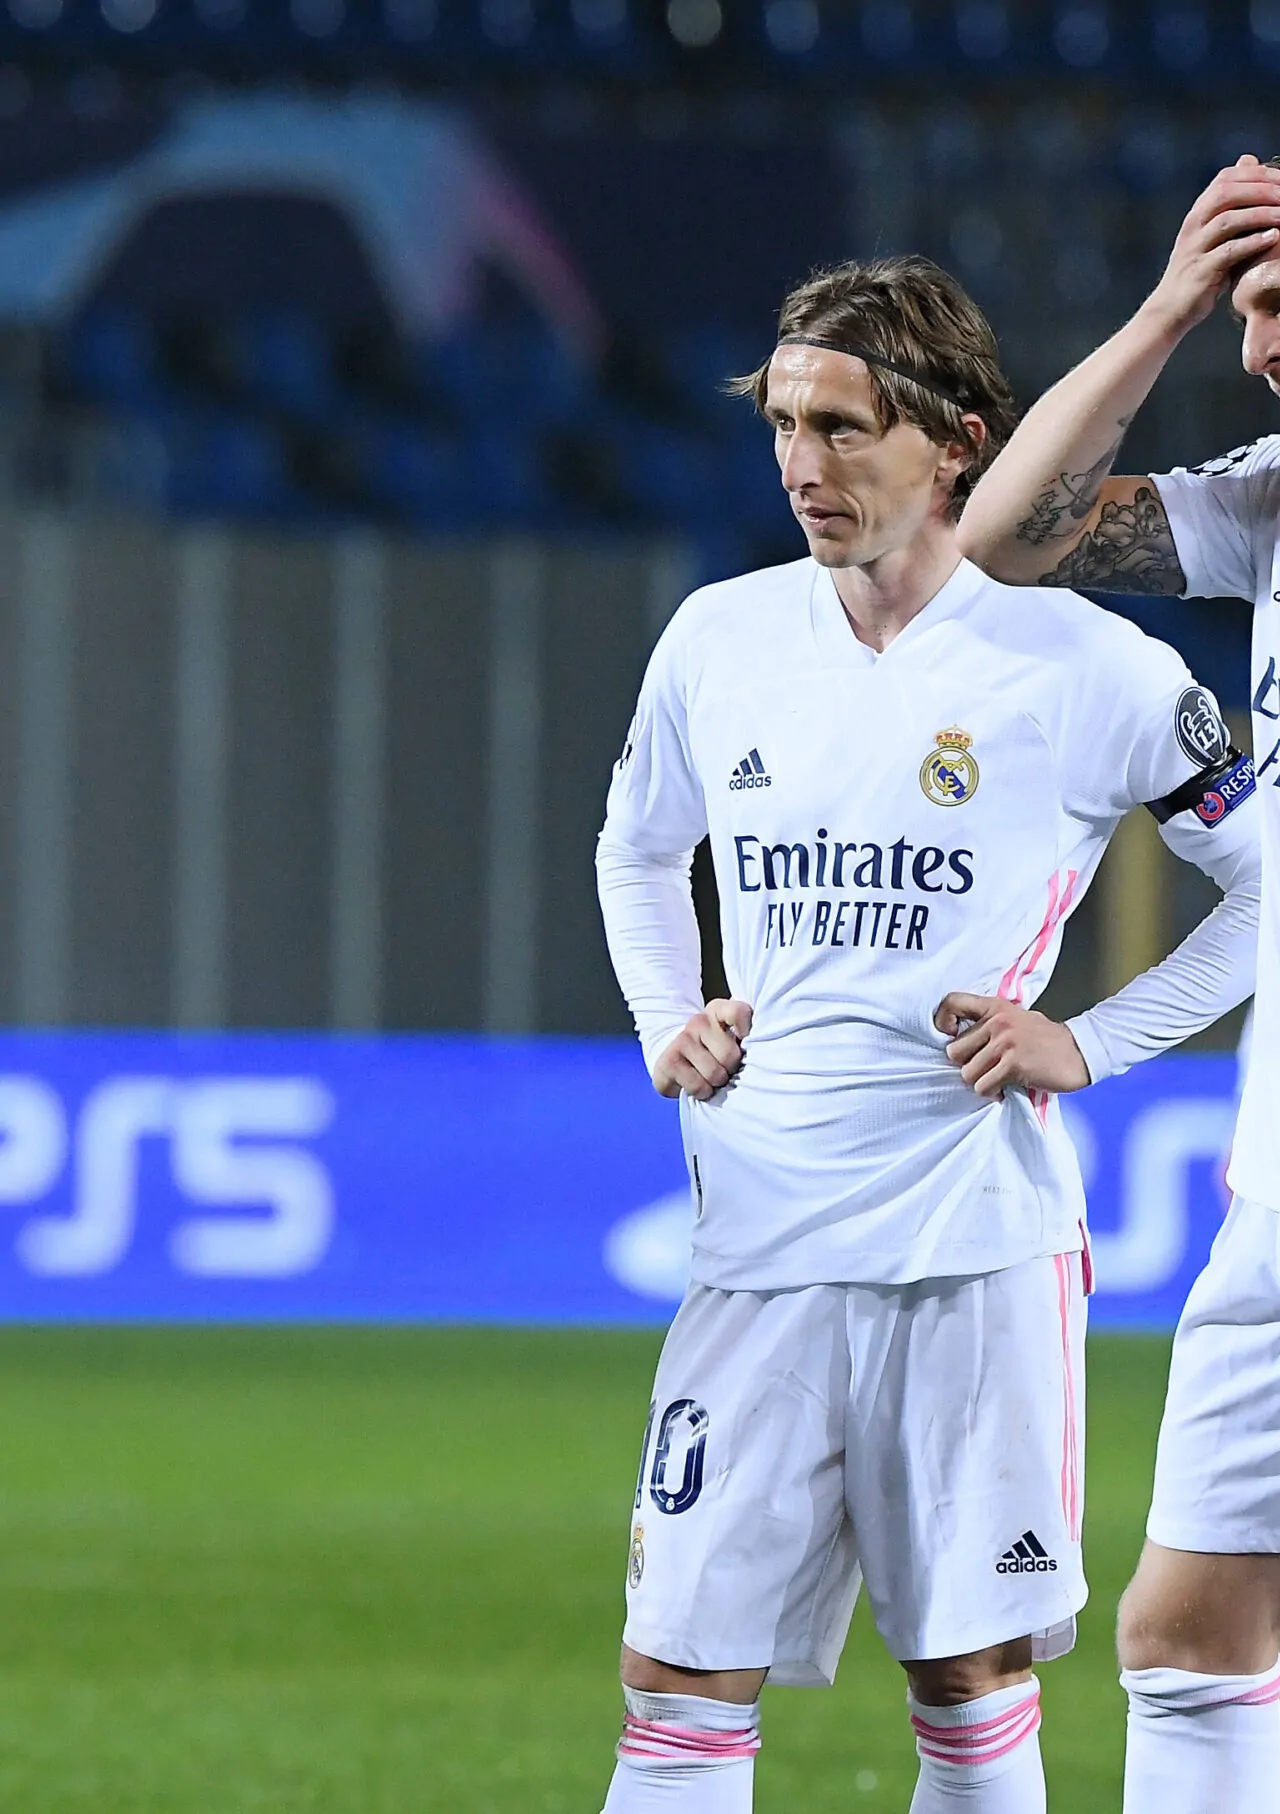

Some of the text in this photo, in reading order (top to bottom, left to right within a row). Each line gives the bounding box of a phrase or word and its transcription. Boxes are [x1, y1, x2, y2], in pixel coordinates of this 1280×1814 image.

[728, 773, 772, 791] adidas
[733, 828, 974, 895] Emirates
[765, 901, 930, 951] FLY BETTER
[995, 1555, 1058, 1574] adidas
